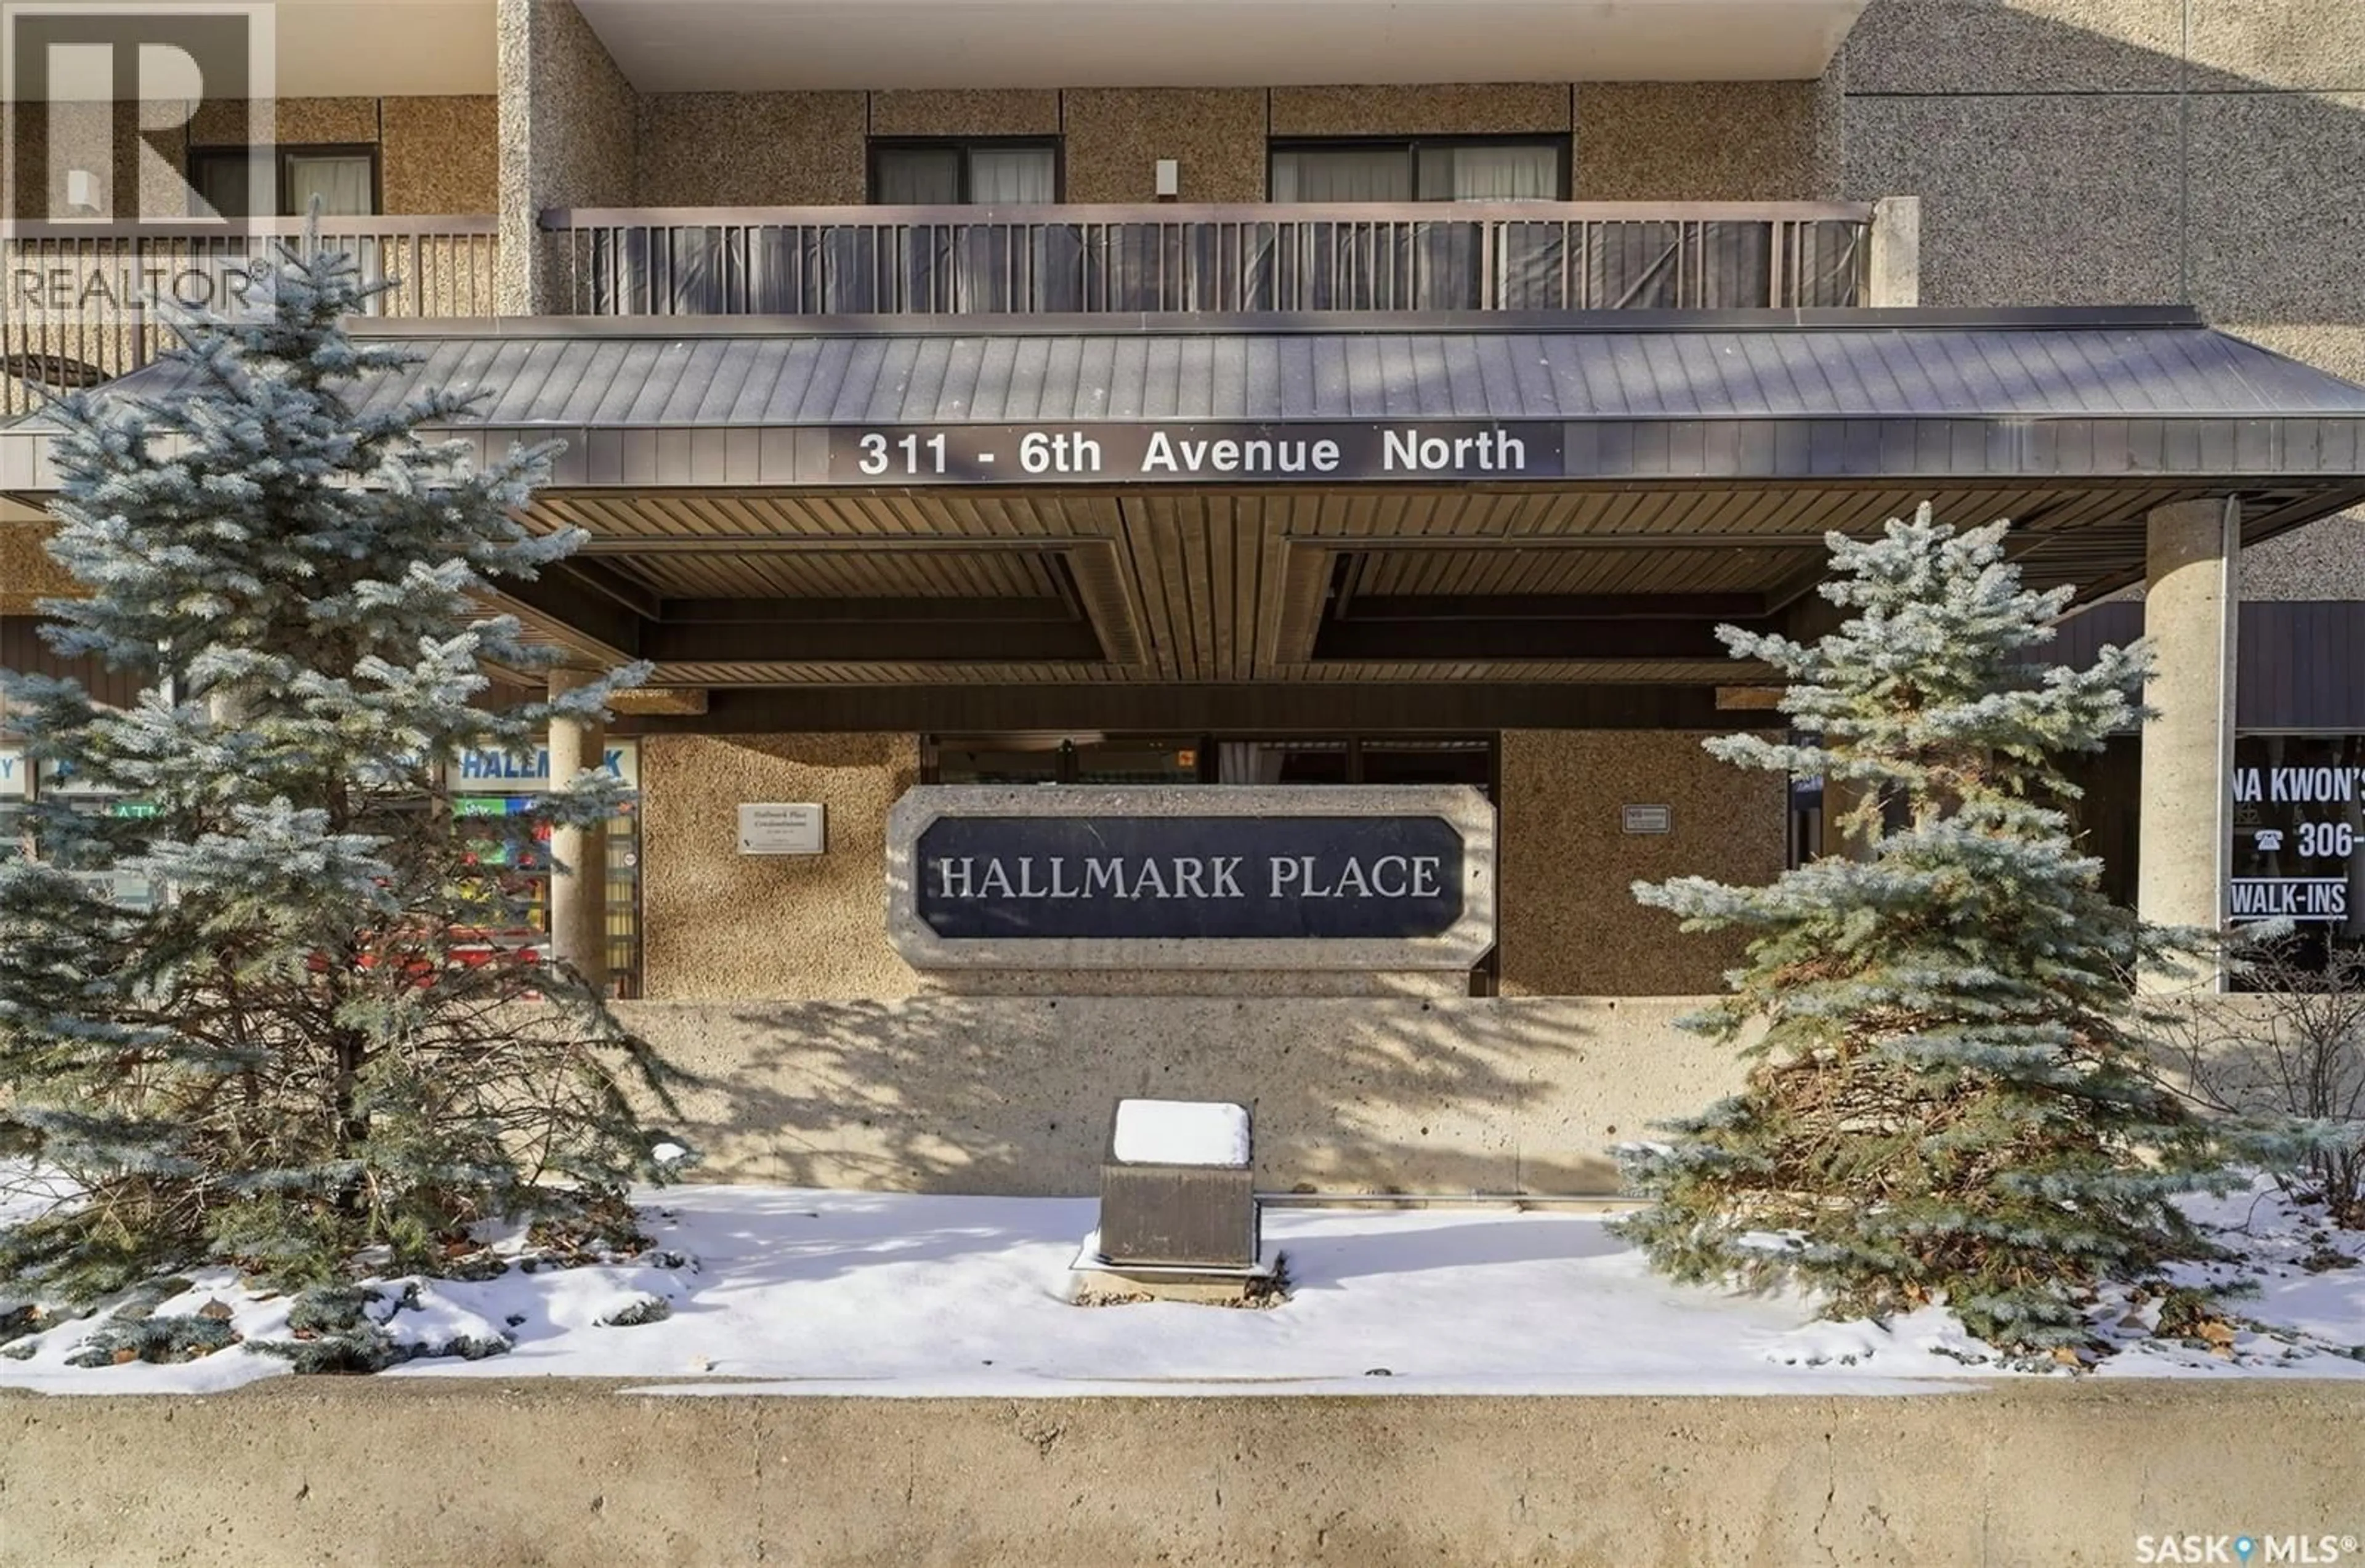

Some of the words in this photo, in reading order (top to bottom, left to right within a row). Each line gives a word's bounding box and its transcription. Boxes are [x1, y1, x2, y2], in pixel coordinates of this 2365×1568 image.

[859, 434, 945, 474] 311
[1019, 432, 1101, 473] 6th
[1141, 431, 1340, 472] Avenue
[1383, 430, 1525, 470] North
[2271, 767, 2365, 801] KWON'
[939, 857, 1244, 897] HALLMARK
[1269, 856, 1441, 897] PLACE
[2231, 884, 2345, 913] WALK-INS
